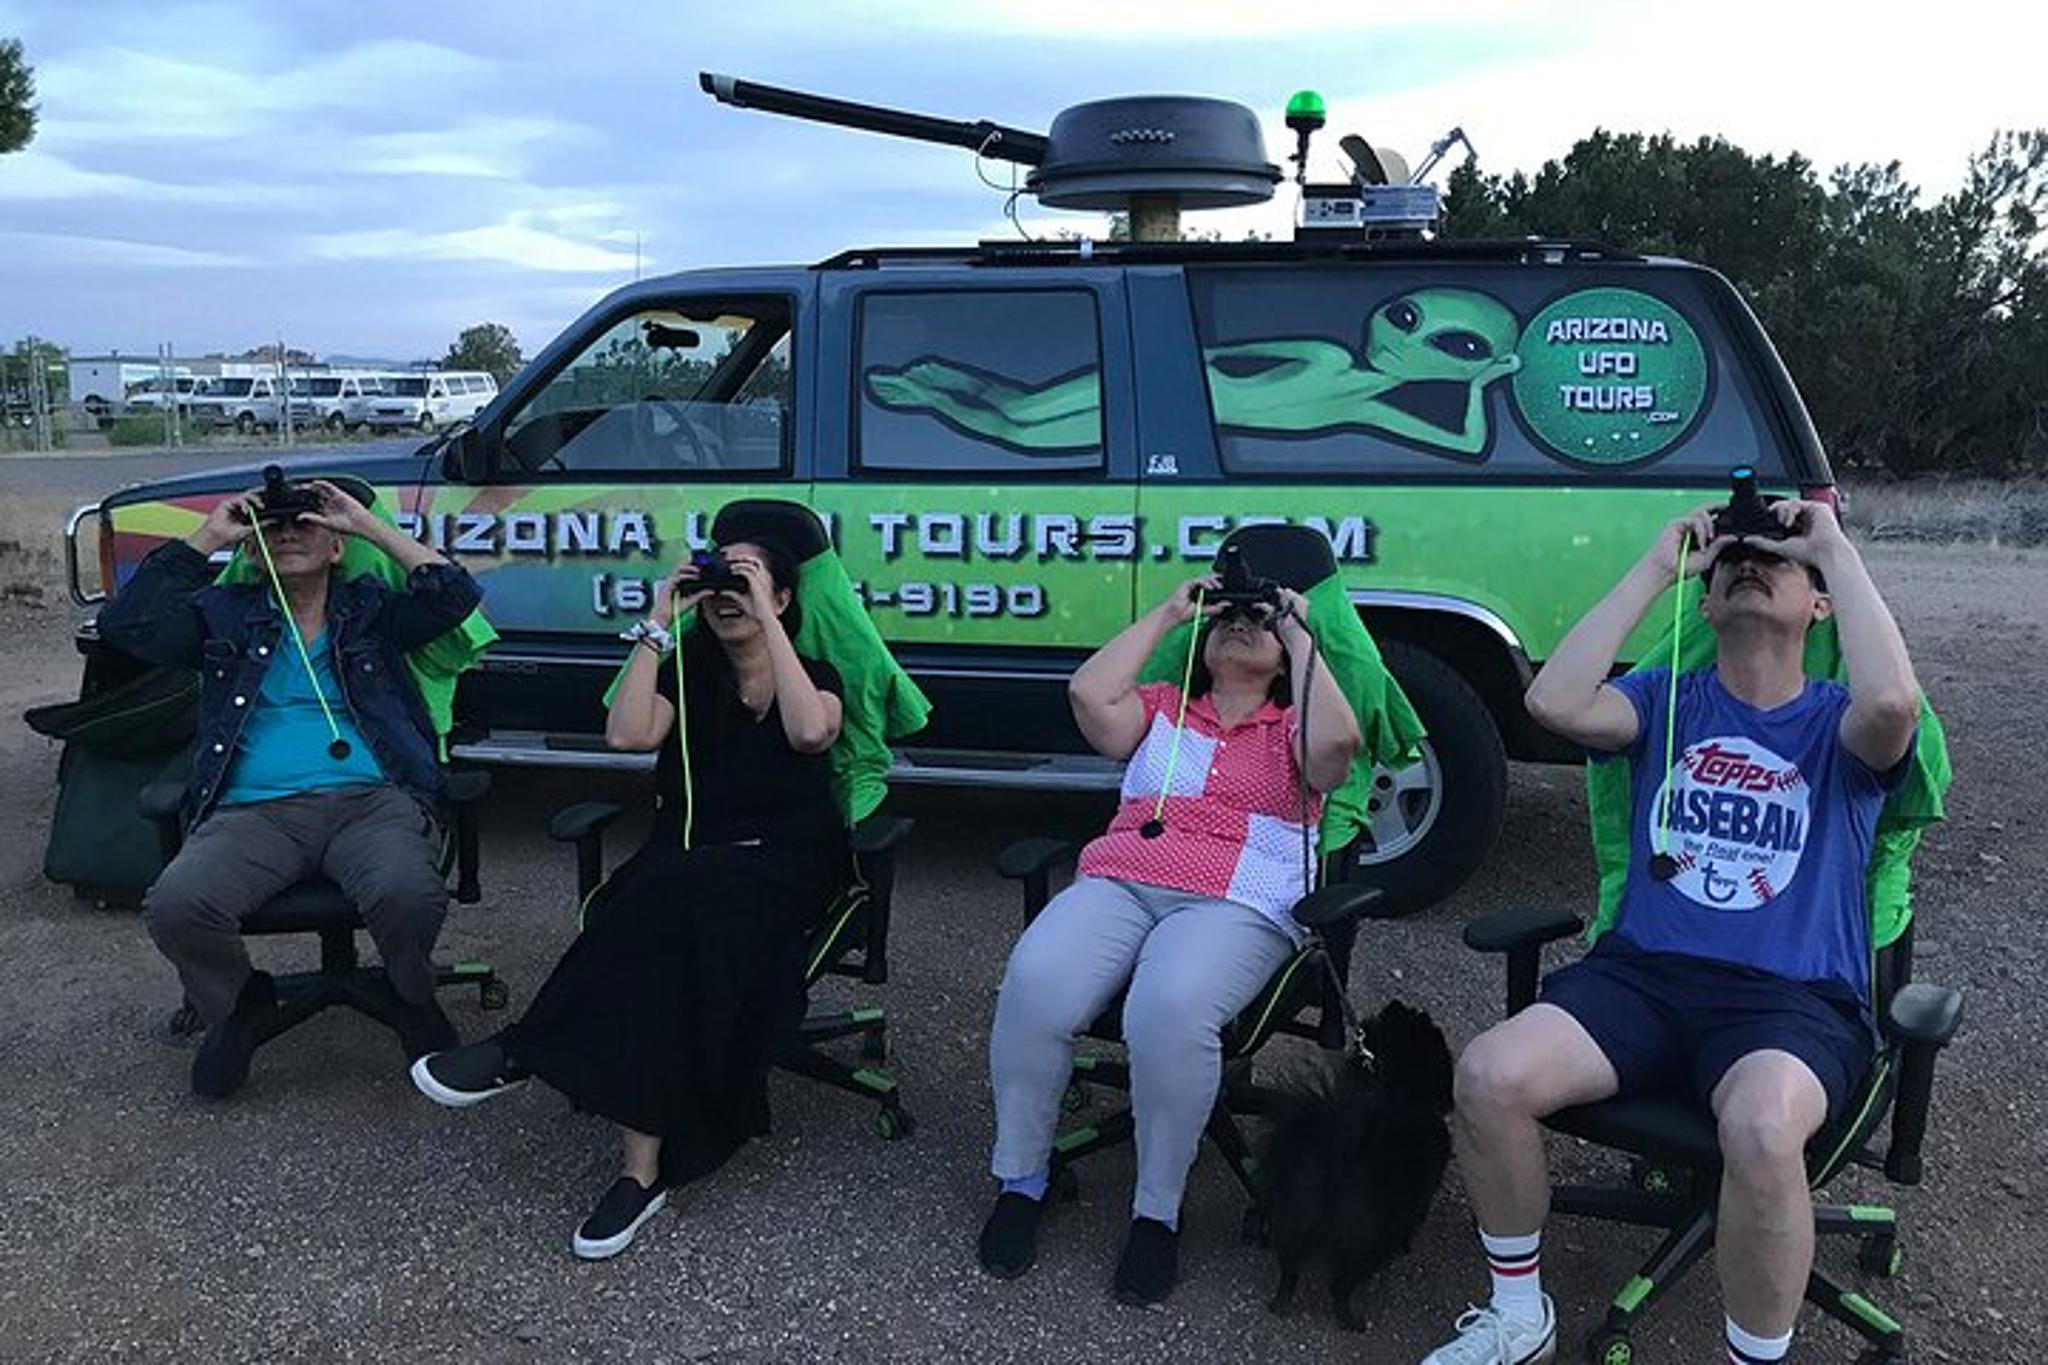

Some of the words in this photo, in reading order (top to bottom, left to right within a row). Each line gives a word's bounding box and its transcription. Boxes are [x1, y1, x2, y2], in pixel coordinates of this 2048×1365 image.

[1547, 317, 1668, 342] ARIZONA
[1578, 351, 1636, 374] UFO
[1560, 385, 1654, 409] TOURS
[870, 513, 1366, 558] TOURS.CM
